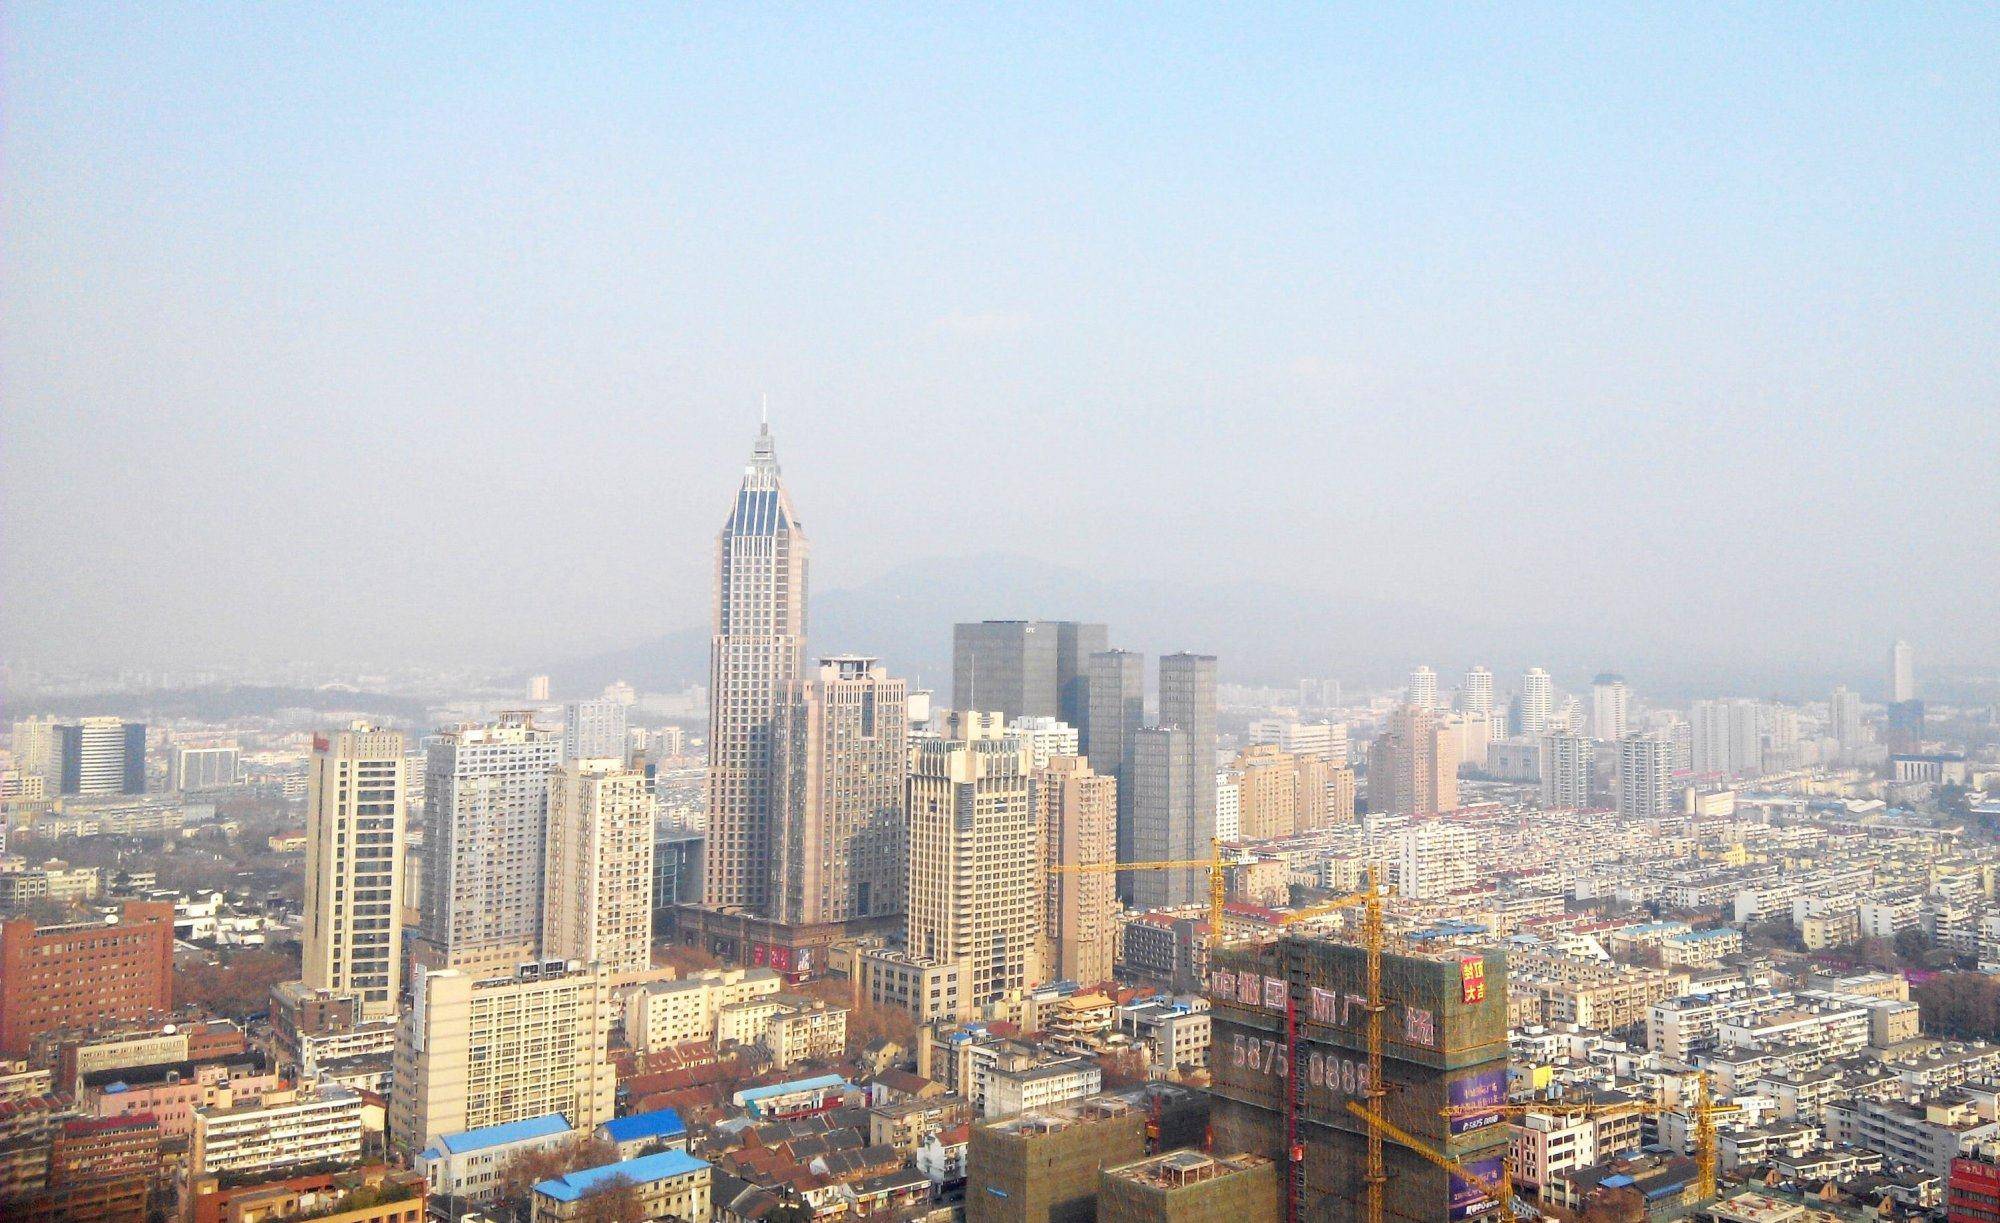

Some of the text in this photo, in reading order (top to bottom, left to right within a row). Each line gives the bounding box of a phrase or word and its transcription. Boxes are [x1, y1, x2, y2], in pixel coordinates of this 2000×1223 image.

[1465, 982, 1484, 1001] 大吉
[1233, 1034, 1371, 1099] 5875 0888
